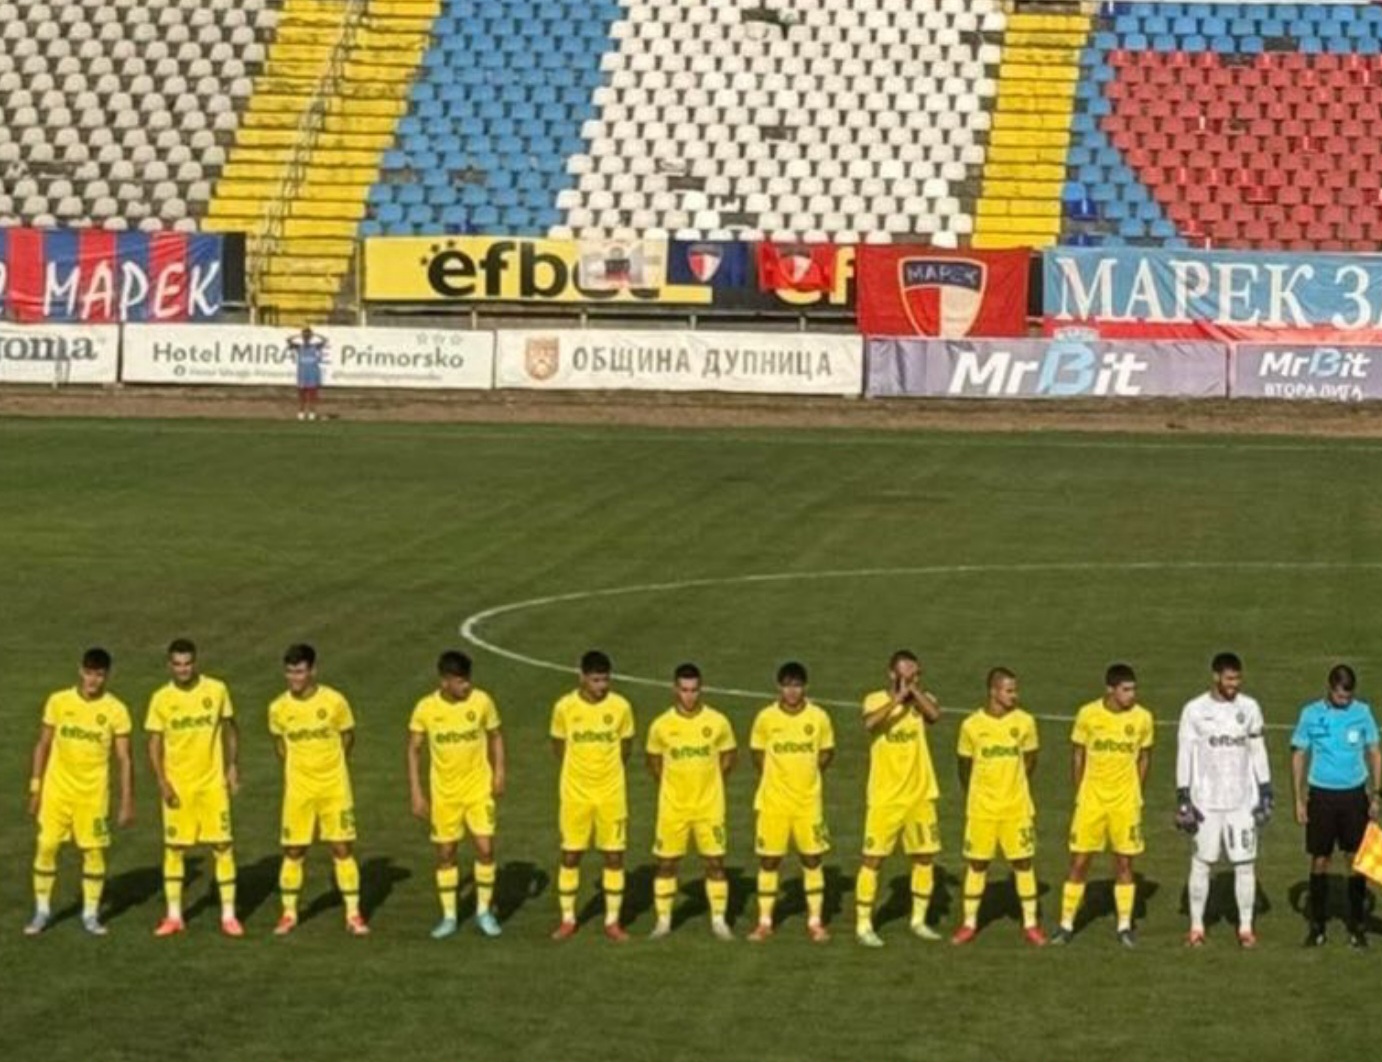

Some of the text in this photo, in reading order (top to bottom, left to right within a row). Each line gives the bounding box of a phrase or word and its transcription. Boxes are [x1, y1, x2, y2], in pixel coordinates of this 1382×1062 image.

[421, 240, 662, 298] efb
[906, 263, 979, 288] МАРЕК
[43, 260, 222, 321] МАРЕК
[1055, 256, 1315, 328] МАРЕК
[0, 336, 98, 361] oma
[153, 342, 465, 369] Hotel MIRAE Primorsko
[1259, 348, 1371, 378] MrBit
[572, 350, 832, 380] ОБЩИНА ДУПНИЦА
[948, 341, 1147, 396] MrBit
